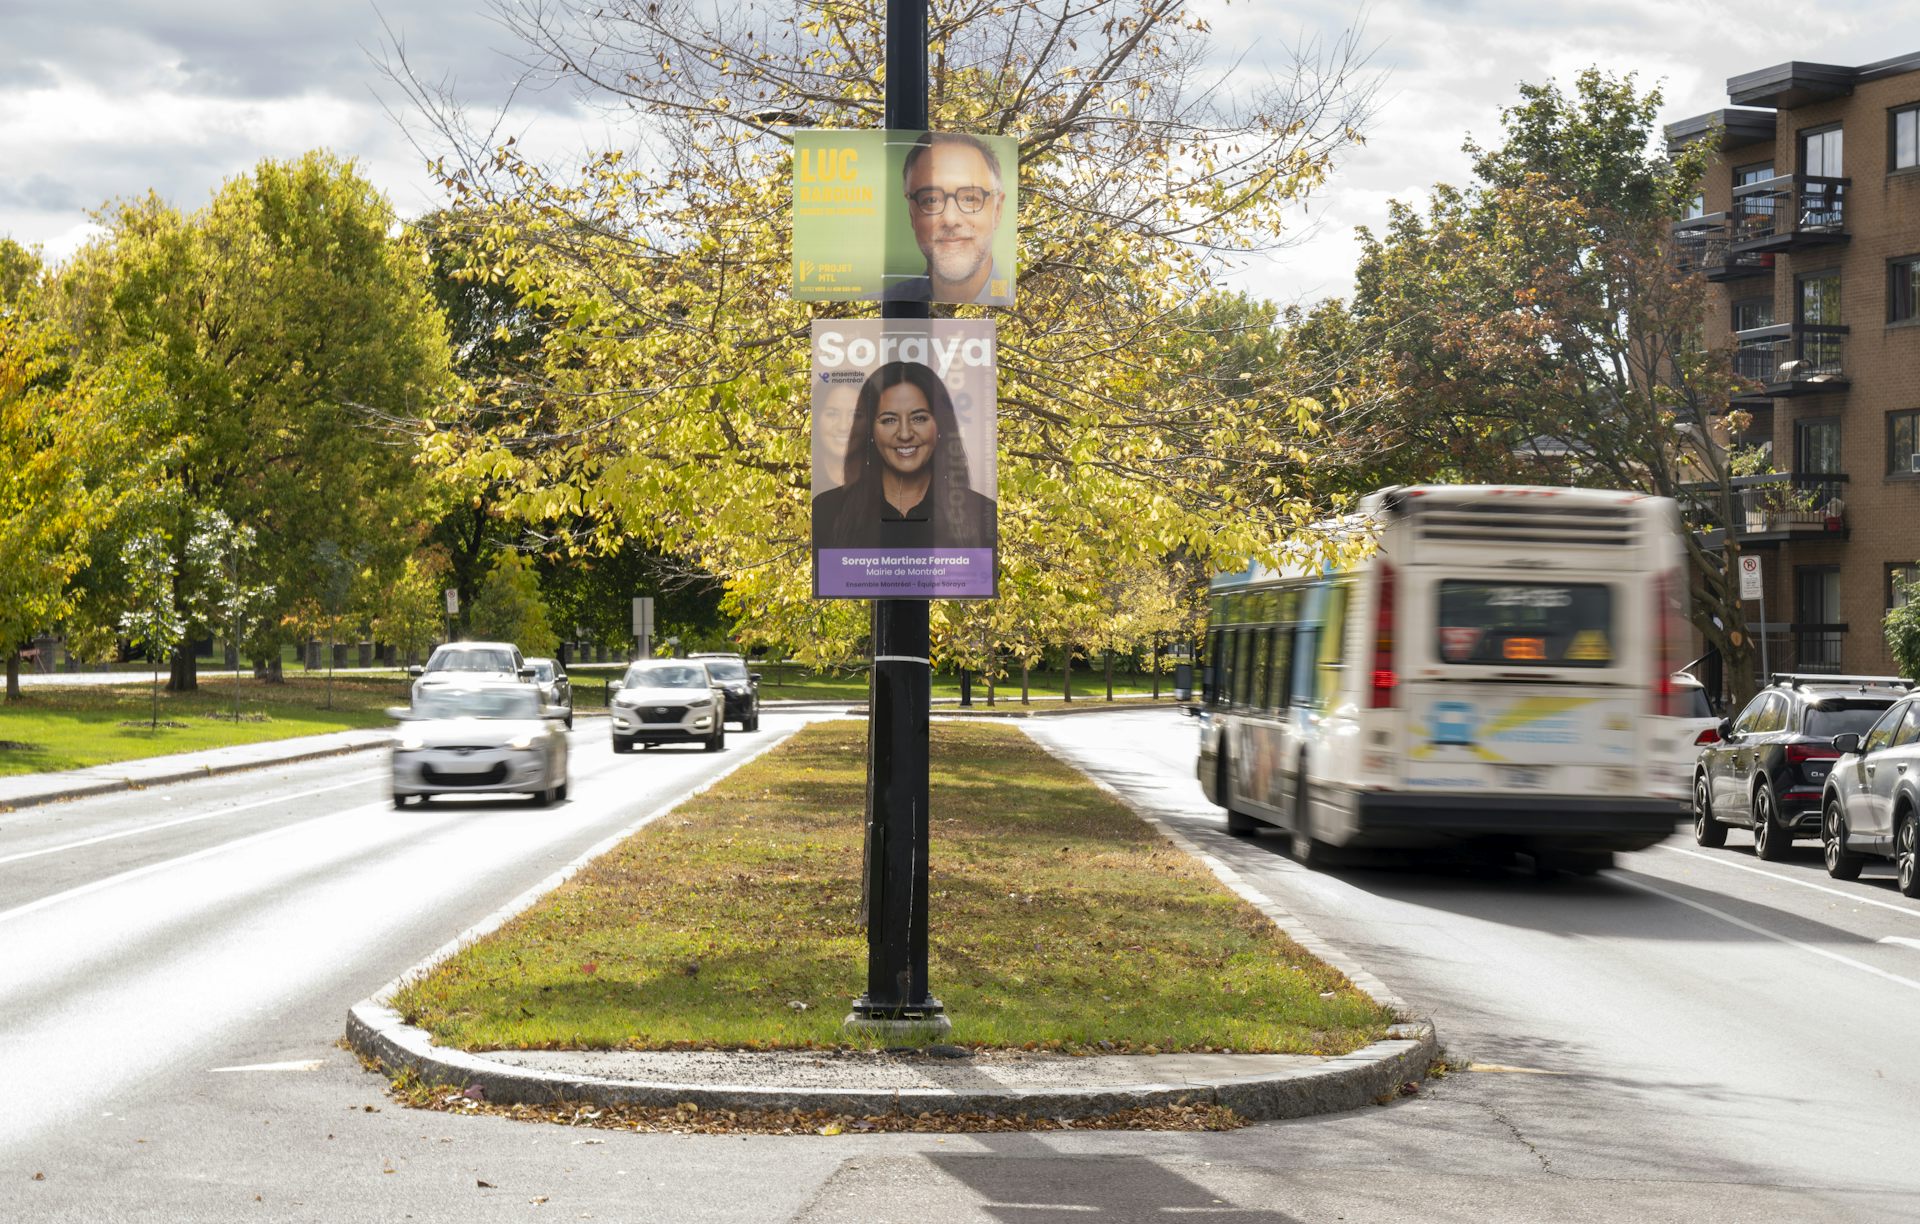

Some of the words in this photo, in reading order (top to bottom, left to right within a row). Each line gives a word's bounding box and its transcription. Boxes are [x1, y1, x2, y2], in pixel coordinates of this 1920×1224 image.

[800, 148, 858, 182] LUC
[818, 264, 853, 273] PROJET
[818, 274, 836, 283] MTL
[818, 331, 991, 379] Soraya
[841, 556, 879, 568] Soraya
[881, 555, 927, 565] Martinez
[928, 555, 970, 565] Ferrada
[866, 568, 893, 576] Mairie
[894, 568, 906, 576] de
[907, 567, 946, 576] Montréal
[941, 581, 966, 589] Soraya
